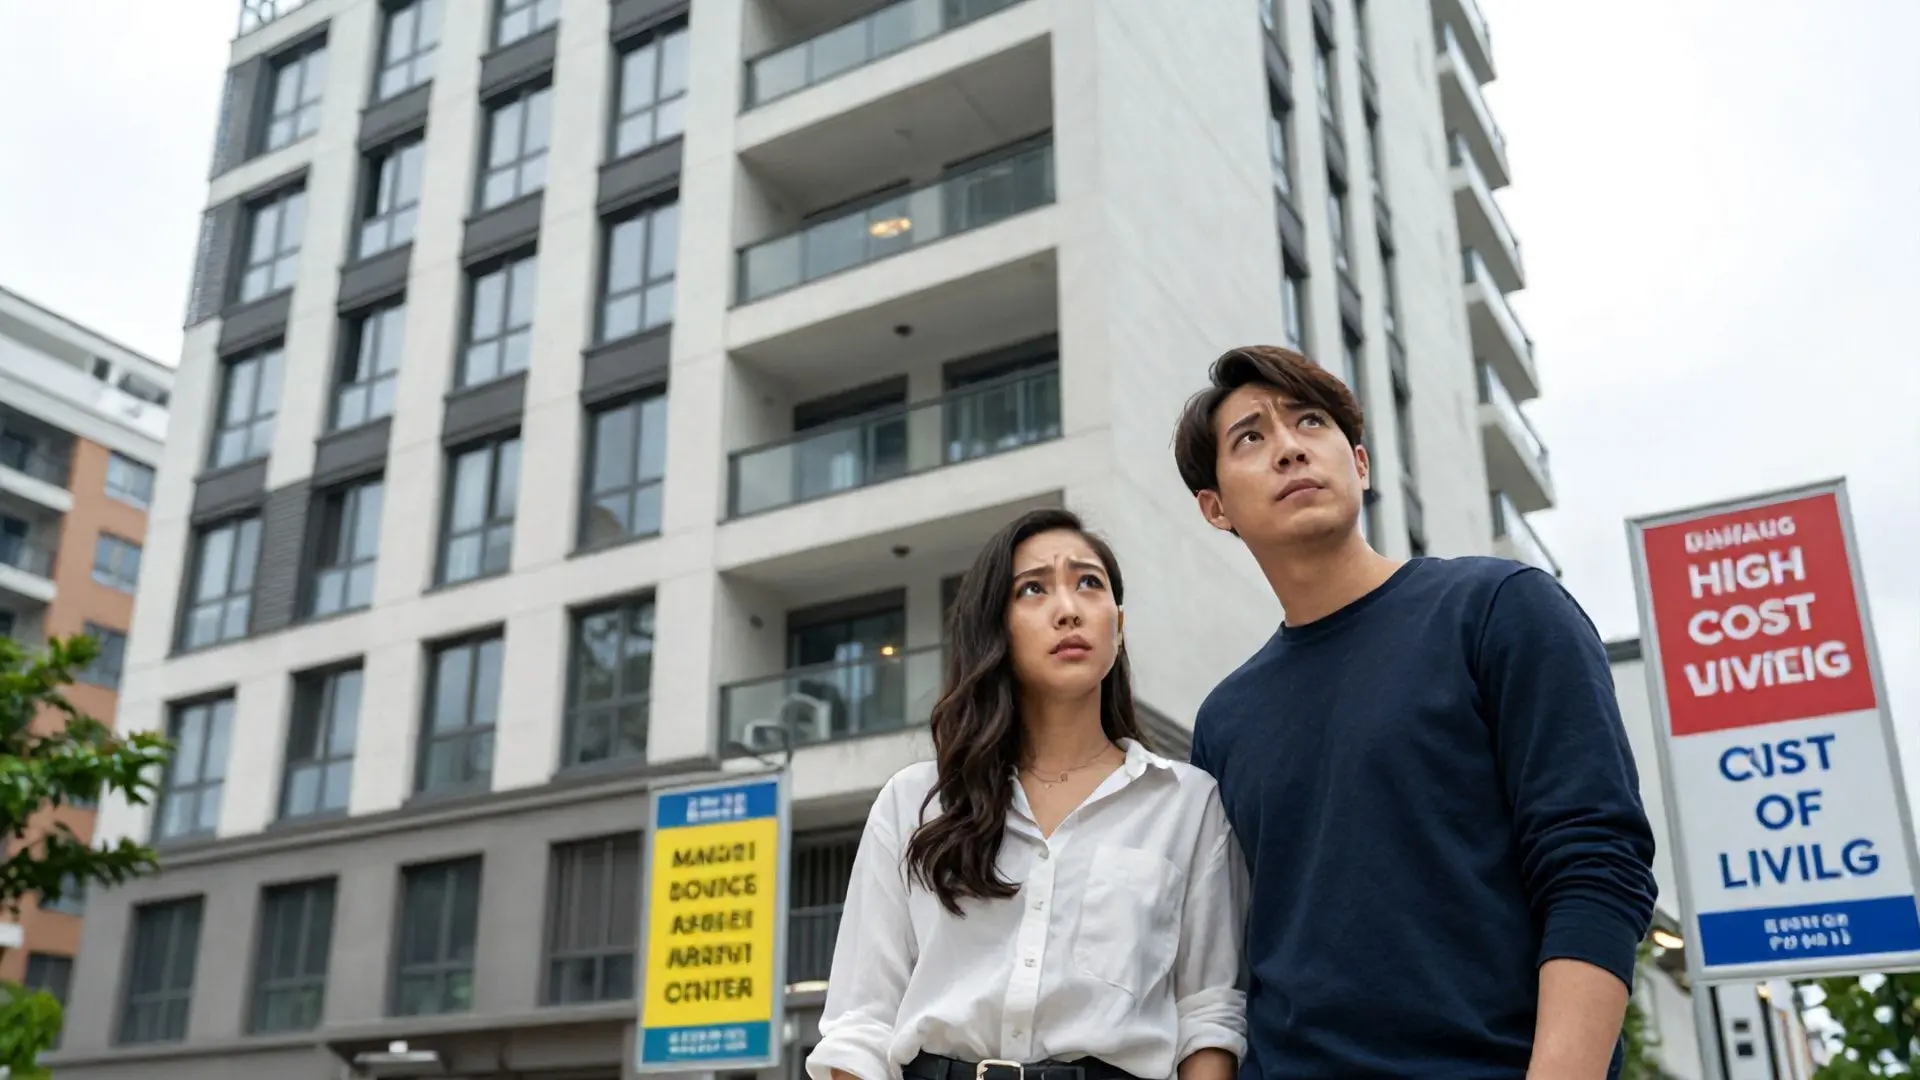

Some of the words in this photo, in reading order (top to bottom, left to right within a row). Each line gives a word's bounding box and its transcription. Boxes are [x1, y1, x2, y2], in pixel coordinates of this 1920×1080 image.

[1688, 546, 1806, 599] HIGH
[1688, 592, 1816, 646] COST
[1756, 789, 1822, 831] OF
[1719, 838, 1880, 889] LIVILG
